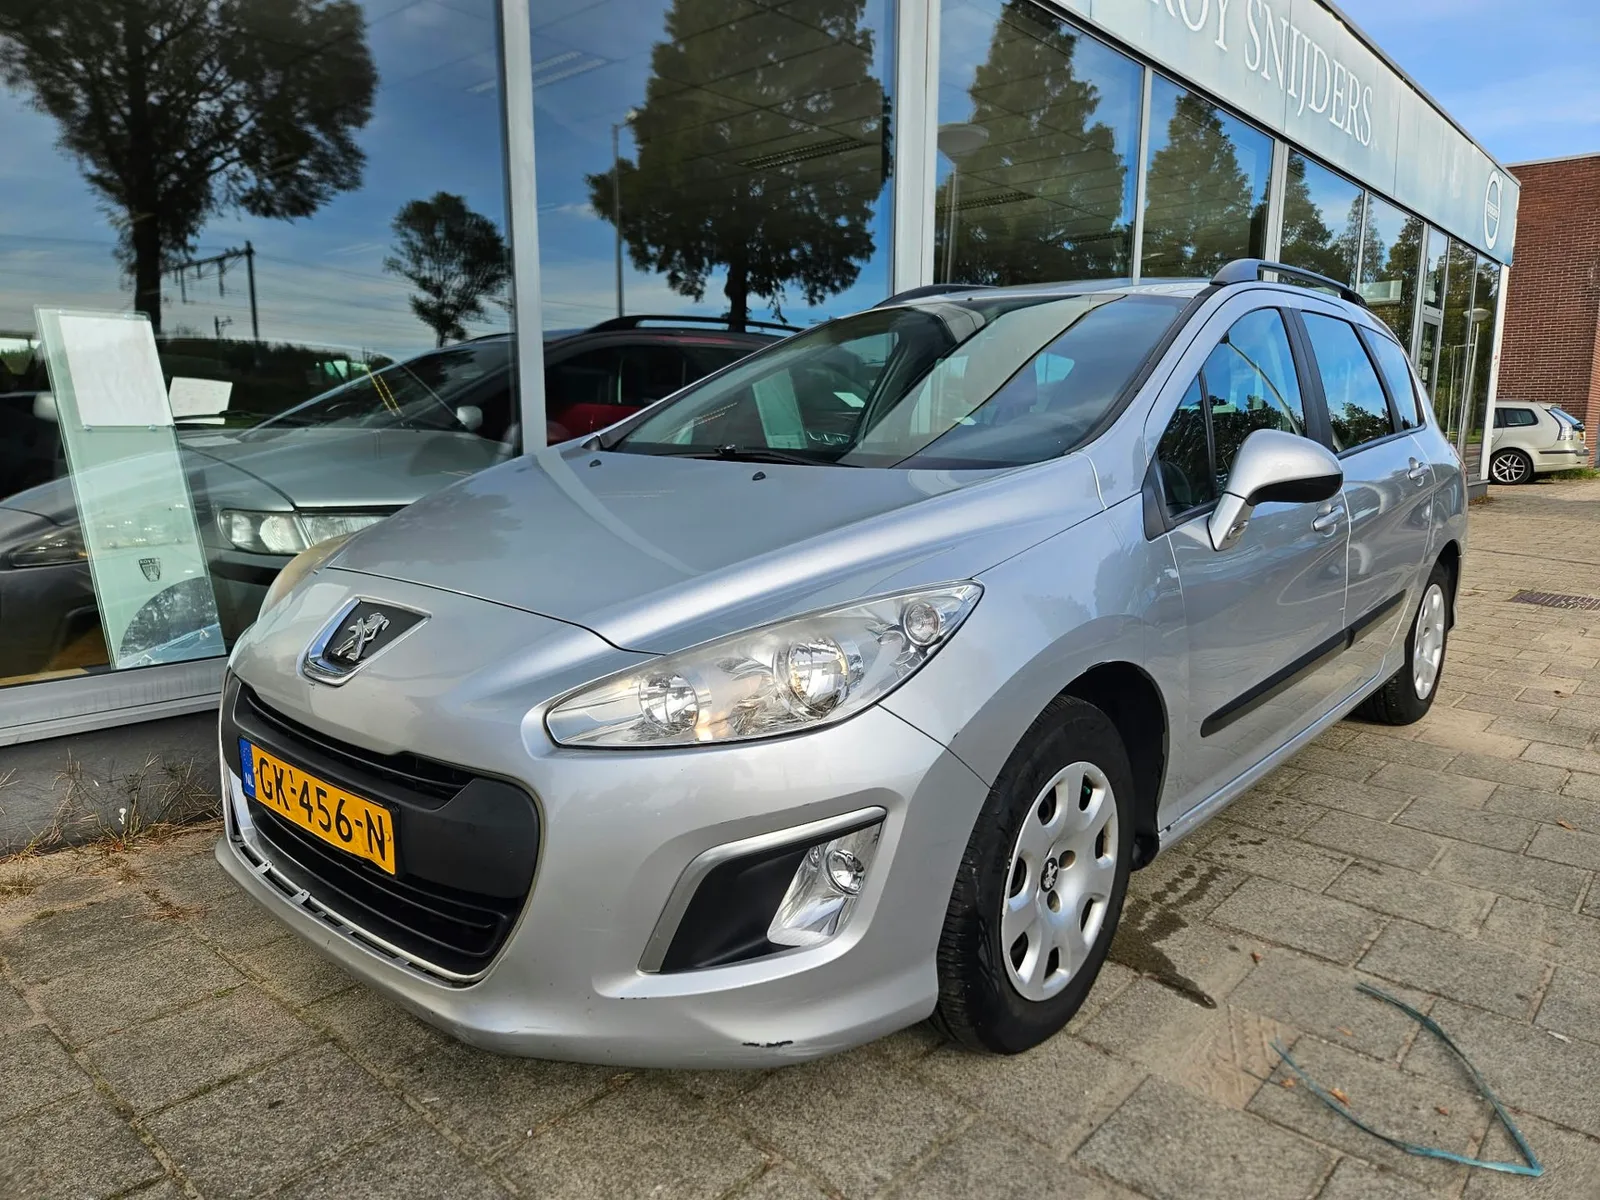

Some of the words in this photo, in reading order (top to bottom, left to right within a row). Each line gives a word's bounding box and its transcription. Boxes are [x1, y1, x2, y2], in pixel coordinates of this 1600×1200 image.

[1244, 0, 1373, 147] SNIJDERS
[245, 772, 255, 789] NL
[259, 757, 387, 862] GK-456-N
